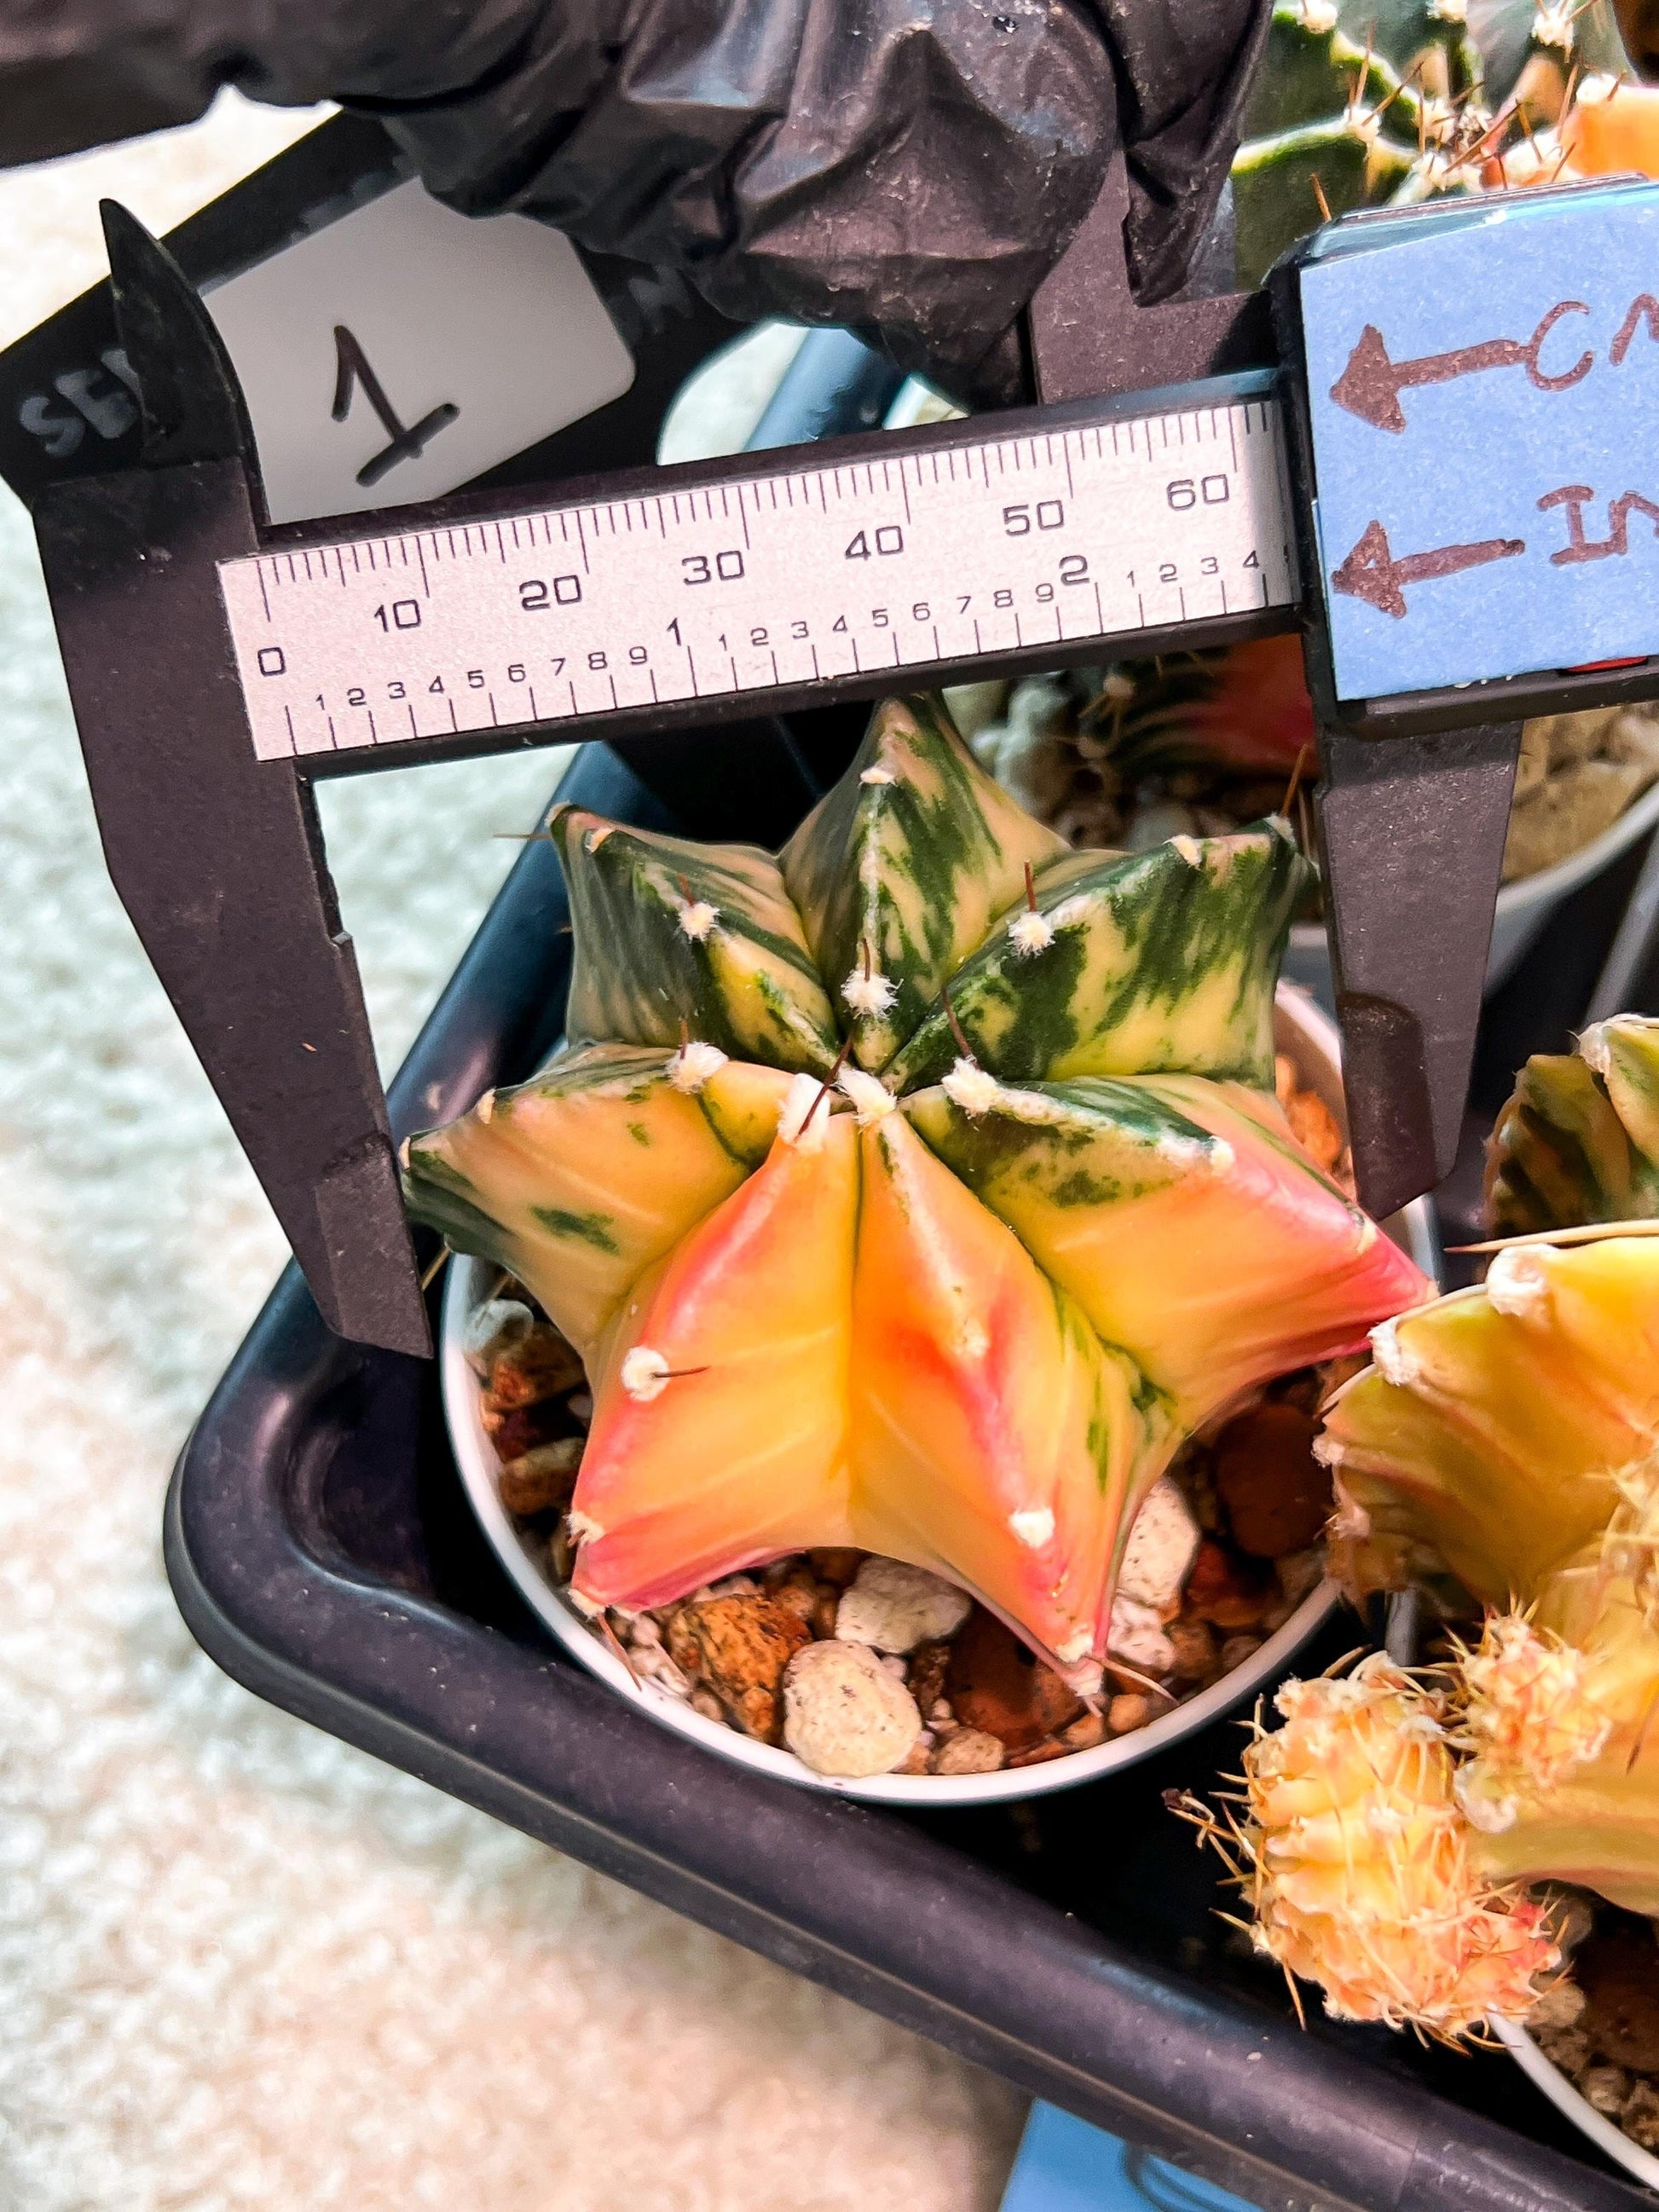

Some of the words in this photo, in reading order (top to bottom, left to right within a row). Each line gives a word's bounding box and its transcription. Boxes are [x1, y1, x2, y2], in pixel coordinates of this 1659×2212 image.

[332, 324, 460, 488] 1
[257, 647, 286, 677] 0
[373, 599, 421, 632] 10
[519, 575, 582, 611] 20
[681, 551, 745, 586] 30
[844, 525, 904, 561] 40
[1003, 500, 1065, 537] 50
[1166, 474, 1229, 511] 60
[315, 694, 325, 710] 1
[346, 688, 367, 707] 2
[387, 682, 407, 699] 3
[429, 676, 445, 694] 4
[466, 669, 485, 689] 5
[507, 663, 526, 683] 6
[550, 657, 566, 676] 7
[587, 651, 608, 670] 8
[629, 646, 648, 666] 9
[666, 617, 681, 646] 1
[718, 634, 727, 651] 1
[750, 627, 769, 646] 2
[791, 621, 810, 639] 3
[832, 615, 848, 632] 4
[872, 609, 888, 627] 5
[912, 603, 931, 621] 6
[956, 596, 972, 614] 7
[993, 589, 1014, 608] 8
[1035, 583, 1055, 603] 9
[1059, 555, 1090, 586] 2
[1126, 570, 1136, 587] 1
[1159, 563, 1178, 583] 2
[1201, 557, 1219, 575] 3
[1242, 550, 1259, 569] 4
